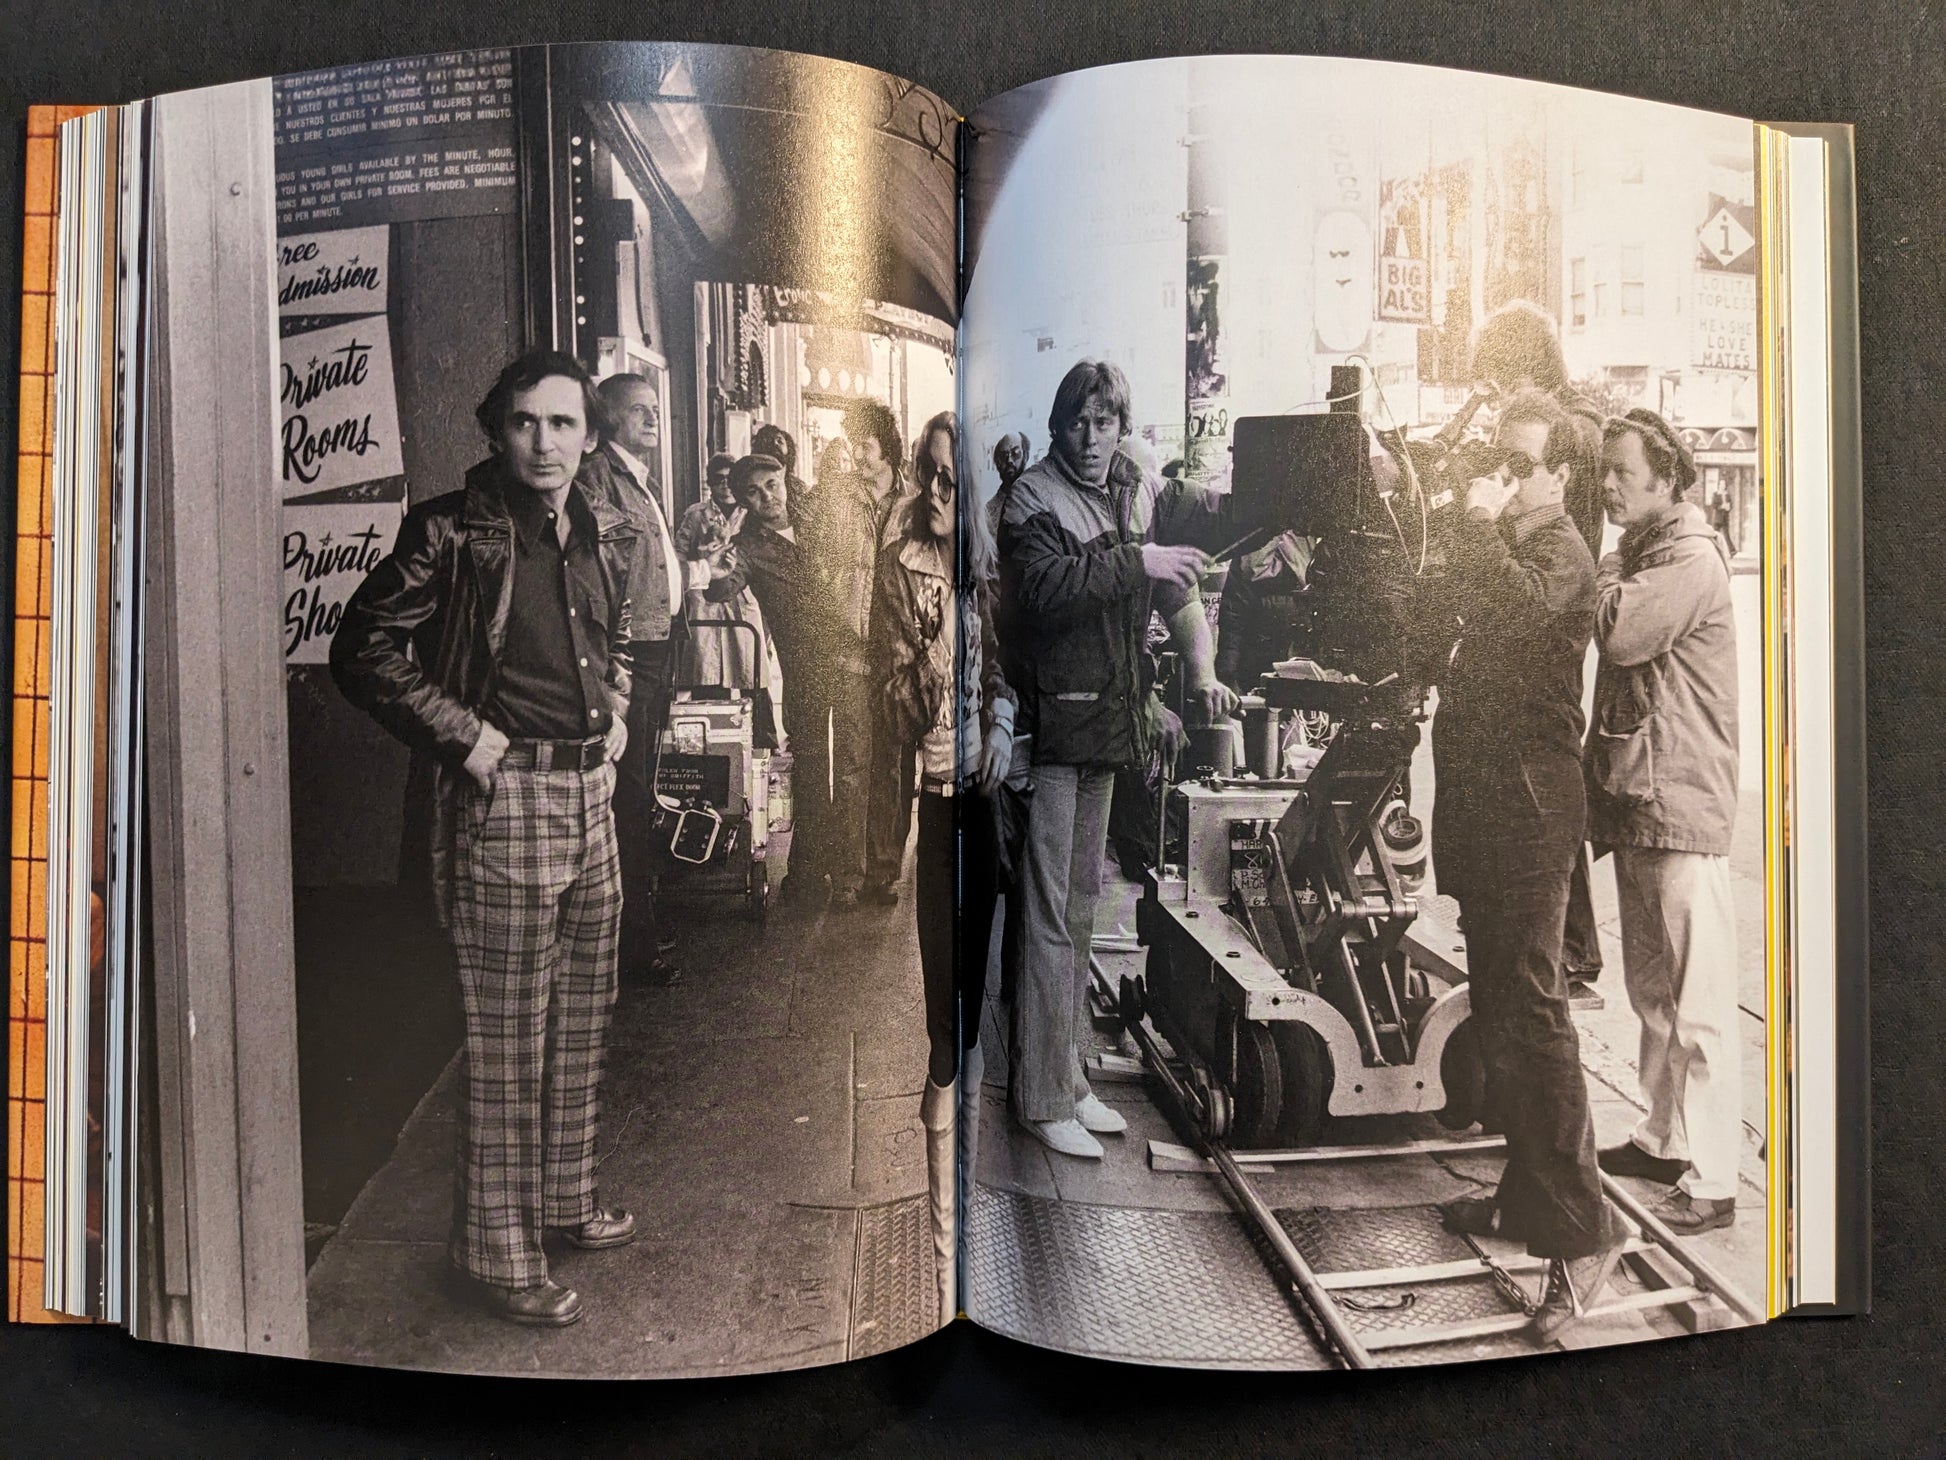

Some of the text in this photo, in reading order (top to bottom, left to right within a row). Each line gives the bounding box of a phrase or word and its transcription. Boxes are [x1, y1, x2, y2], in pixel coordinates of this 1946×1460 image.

[286, 115, 325, 130] NUESTROS
[330, 109, 366, 123] CLIENTES
[371, 106, 378, 116] Y
[383, 101, 426, 115] NUESTRAS
[433, 97, 473, 109] MUJERES
[479, 94, 497, 106] POR
[289, 133, 300, 143] SE
[304, 130, 323, 142] DEBE
[327, 122, 367, 138] CONSUMIR
[371, 117, 402, 131] MINIMO
[406, 116, 419, 127] UN
[423, 113, 451, 125] DOLAR
[455, 111, 472, 122] POR
[281, 185, 297, 196] YOU
[299, 183, 308, 193] IN
[311, 180, 332, 191] YOUR
[334, 178, 352, 189] OWN
[355, 172, 387, 186] PRIVATE
[419, 166, 441, 178] FEES
[443, 164, 461, 176] ARE
[464, 161, 517, 175] NEGOTIABLE
[301, 166, 327, 179] YOUNG
[331, 163, 354, 175] GIRLS
[359, 156, 400, 170] AVAILABLE
[404, 154, 417, 166] BY
[422, 153, 440, 164] THE
[445, 149, 483, 162] MINUTE,
[276, 199, 297, 210] RONS
[300, 196, 317, 207] AND
[320, 193, 337, 204] OUR
[340, 189, 363, 202] GIRLS
[367, 187, 383, 198] FOR
[387, 182, 421, 196] SERVICE
[474, 176, 517, 188] MINIMUM
[278, 241, 320, 267] ree
[278, 256, 380, 307] dmission
[1387, 264, 1422, 287] BIG
[1702, 276, 1752, 294] LOLITA
[1696, 293, 1756, 311] TOPLESS
[1699, 318, 1716, 332] HE
[1730, 320, 1753, 336] SHE
[1707, 335, 1747, 352] LOVE
[1702, 351, 1750, 370] MATES
[282, 414, 379, 484] Rooms
[284, 523, 384, 584] Private
[285, 585, 344, 657] Sho
[1241, 839, 1263, 849] HAR
